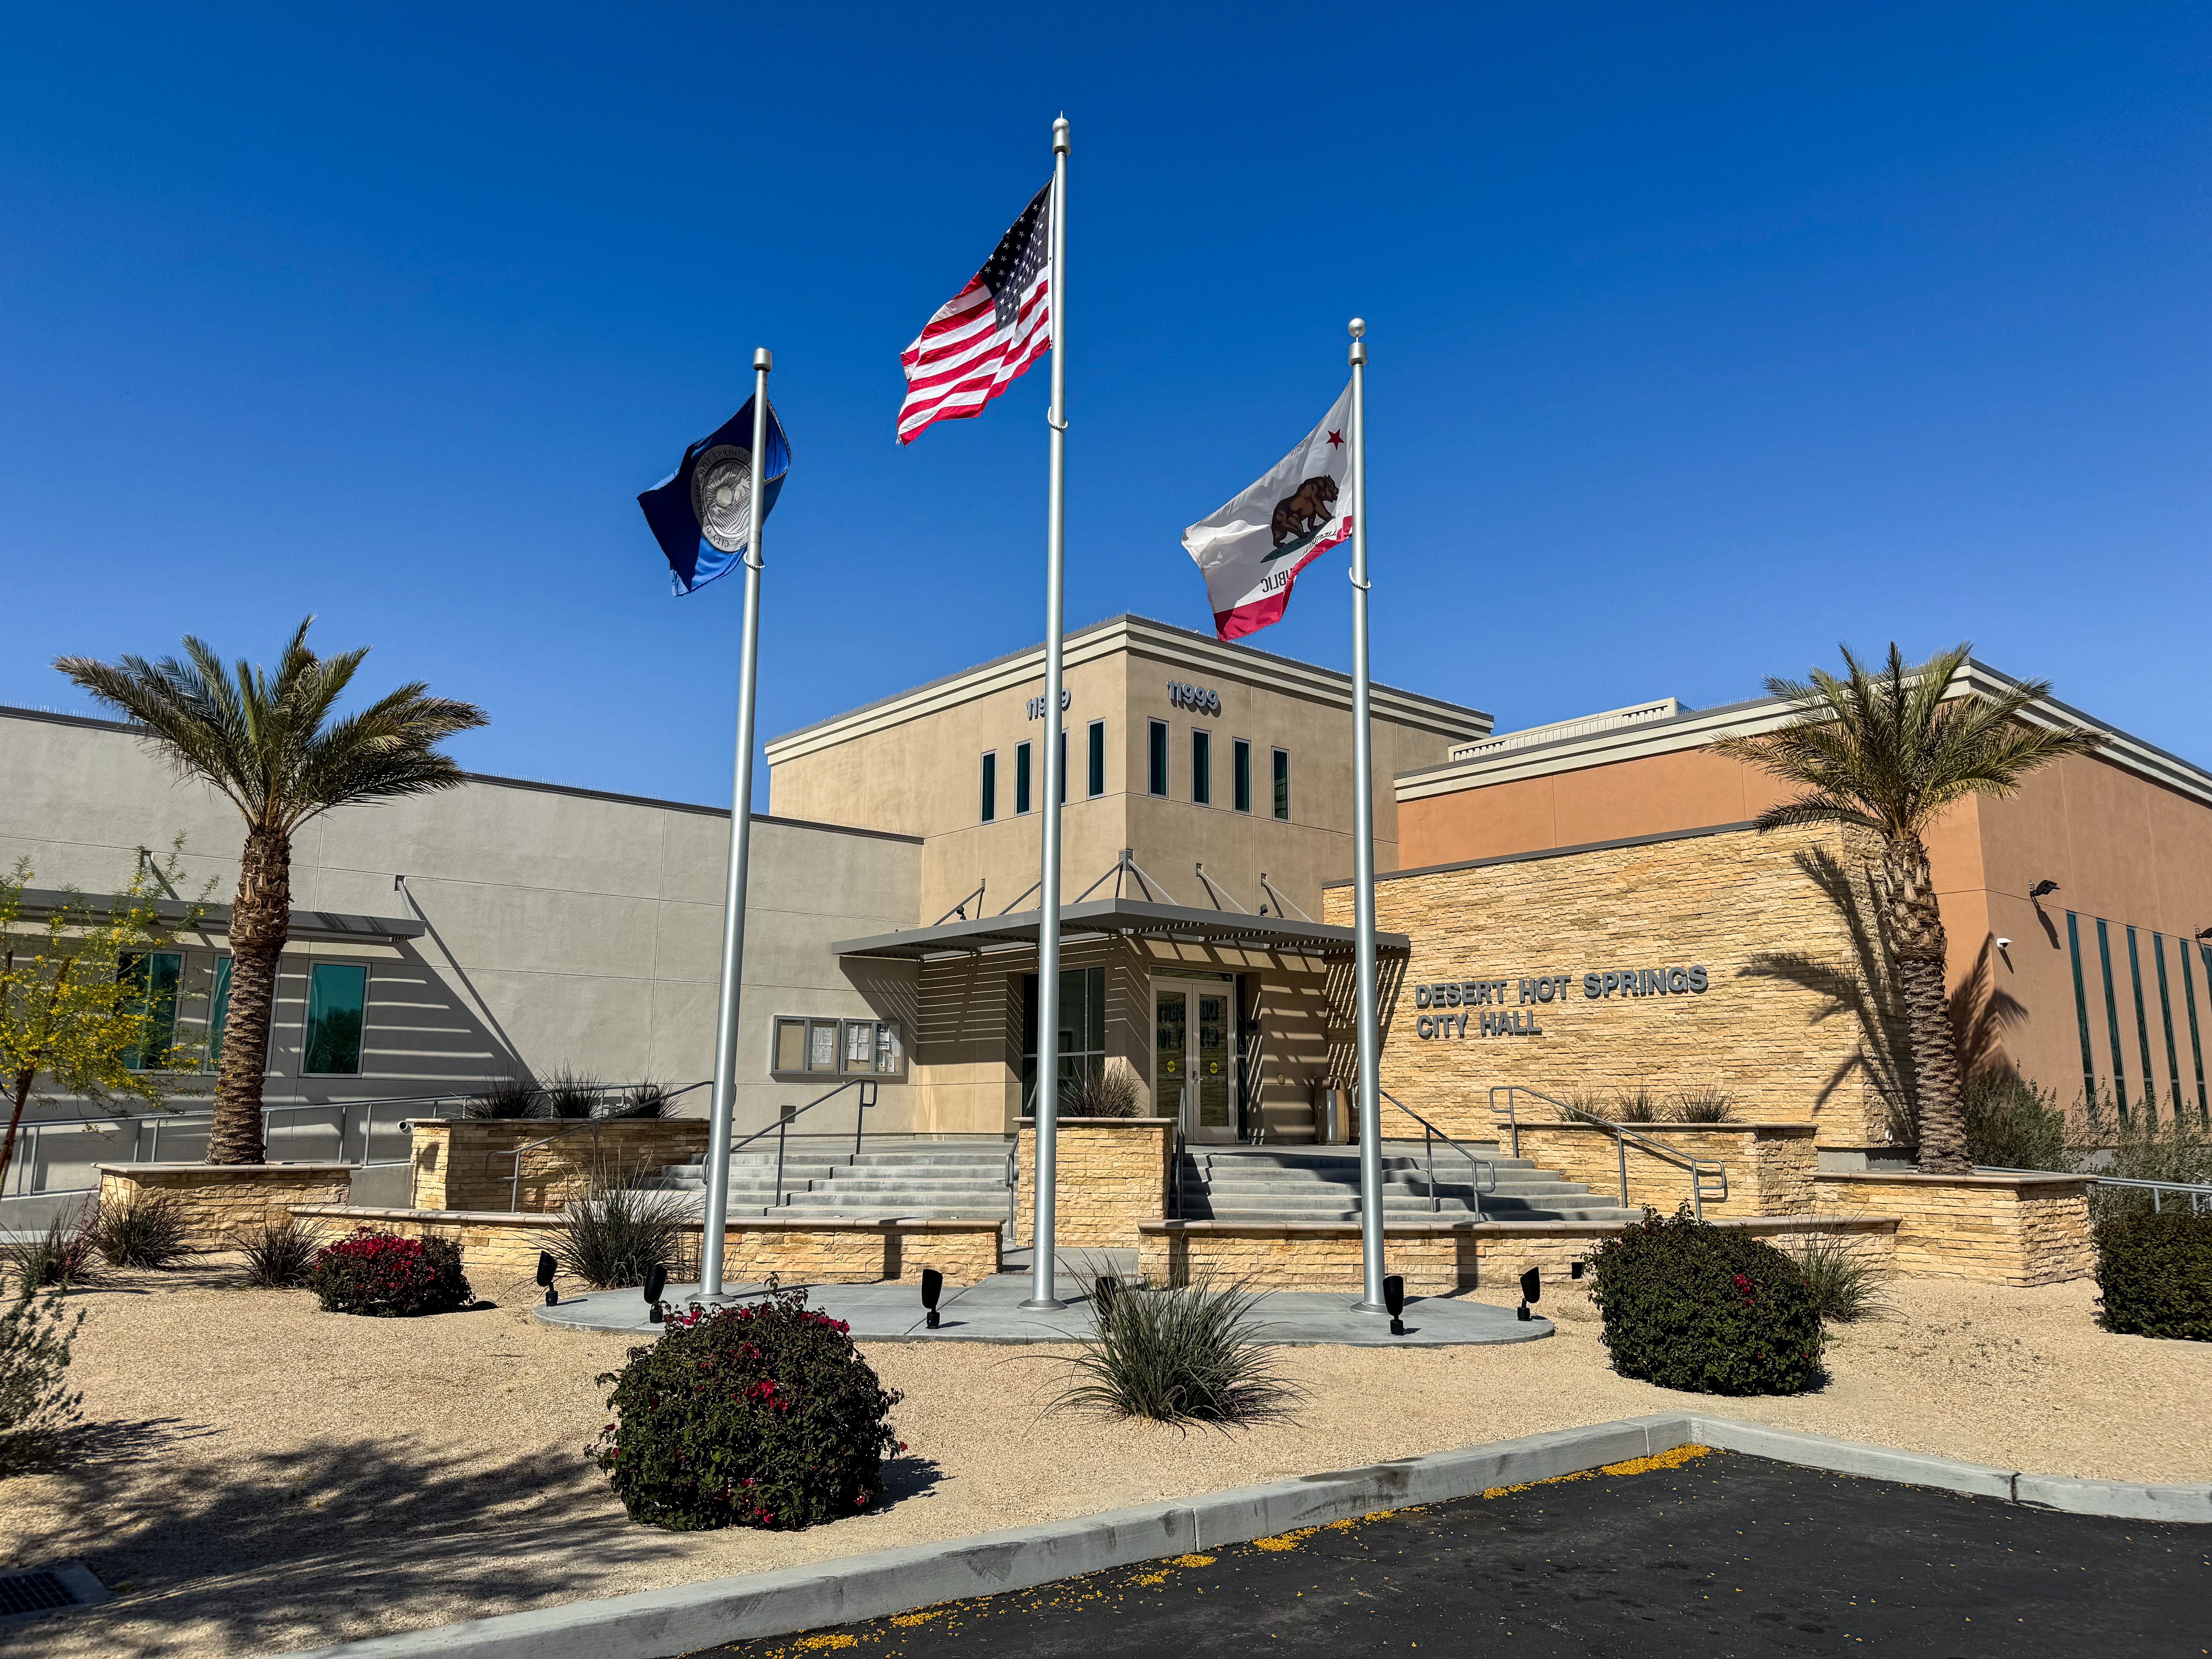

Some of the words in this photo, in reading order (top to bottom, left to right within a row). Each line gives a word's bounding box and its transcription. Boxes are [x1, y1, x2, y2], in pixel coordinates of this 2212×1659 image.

[699, 457, 711, 476] HOT
[712, 534, 729, 547] CITY
[1026, 688, 1070, 719] 1199
[1166, 680, 1219, 710] 11999
[1415, 980, 1507, 1008] DESERT
[1519, 975, 1571, 1005] HOT
[1583, 965, 1708, 1000] SPRINGS
[1416, 1013, 1468, 1040] CITY
[1480, 1010, 1542, 1038] HALL
